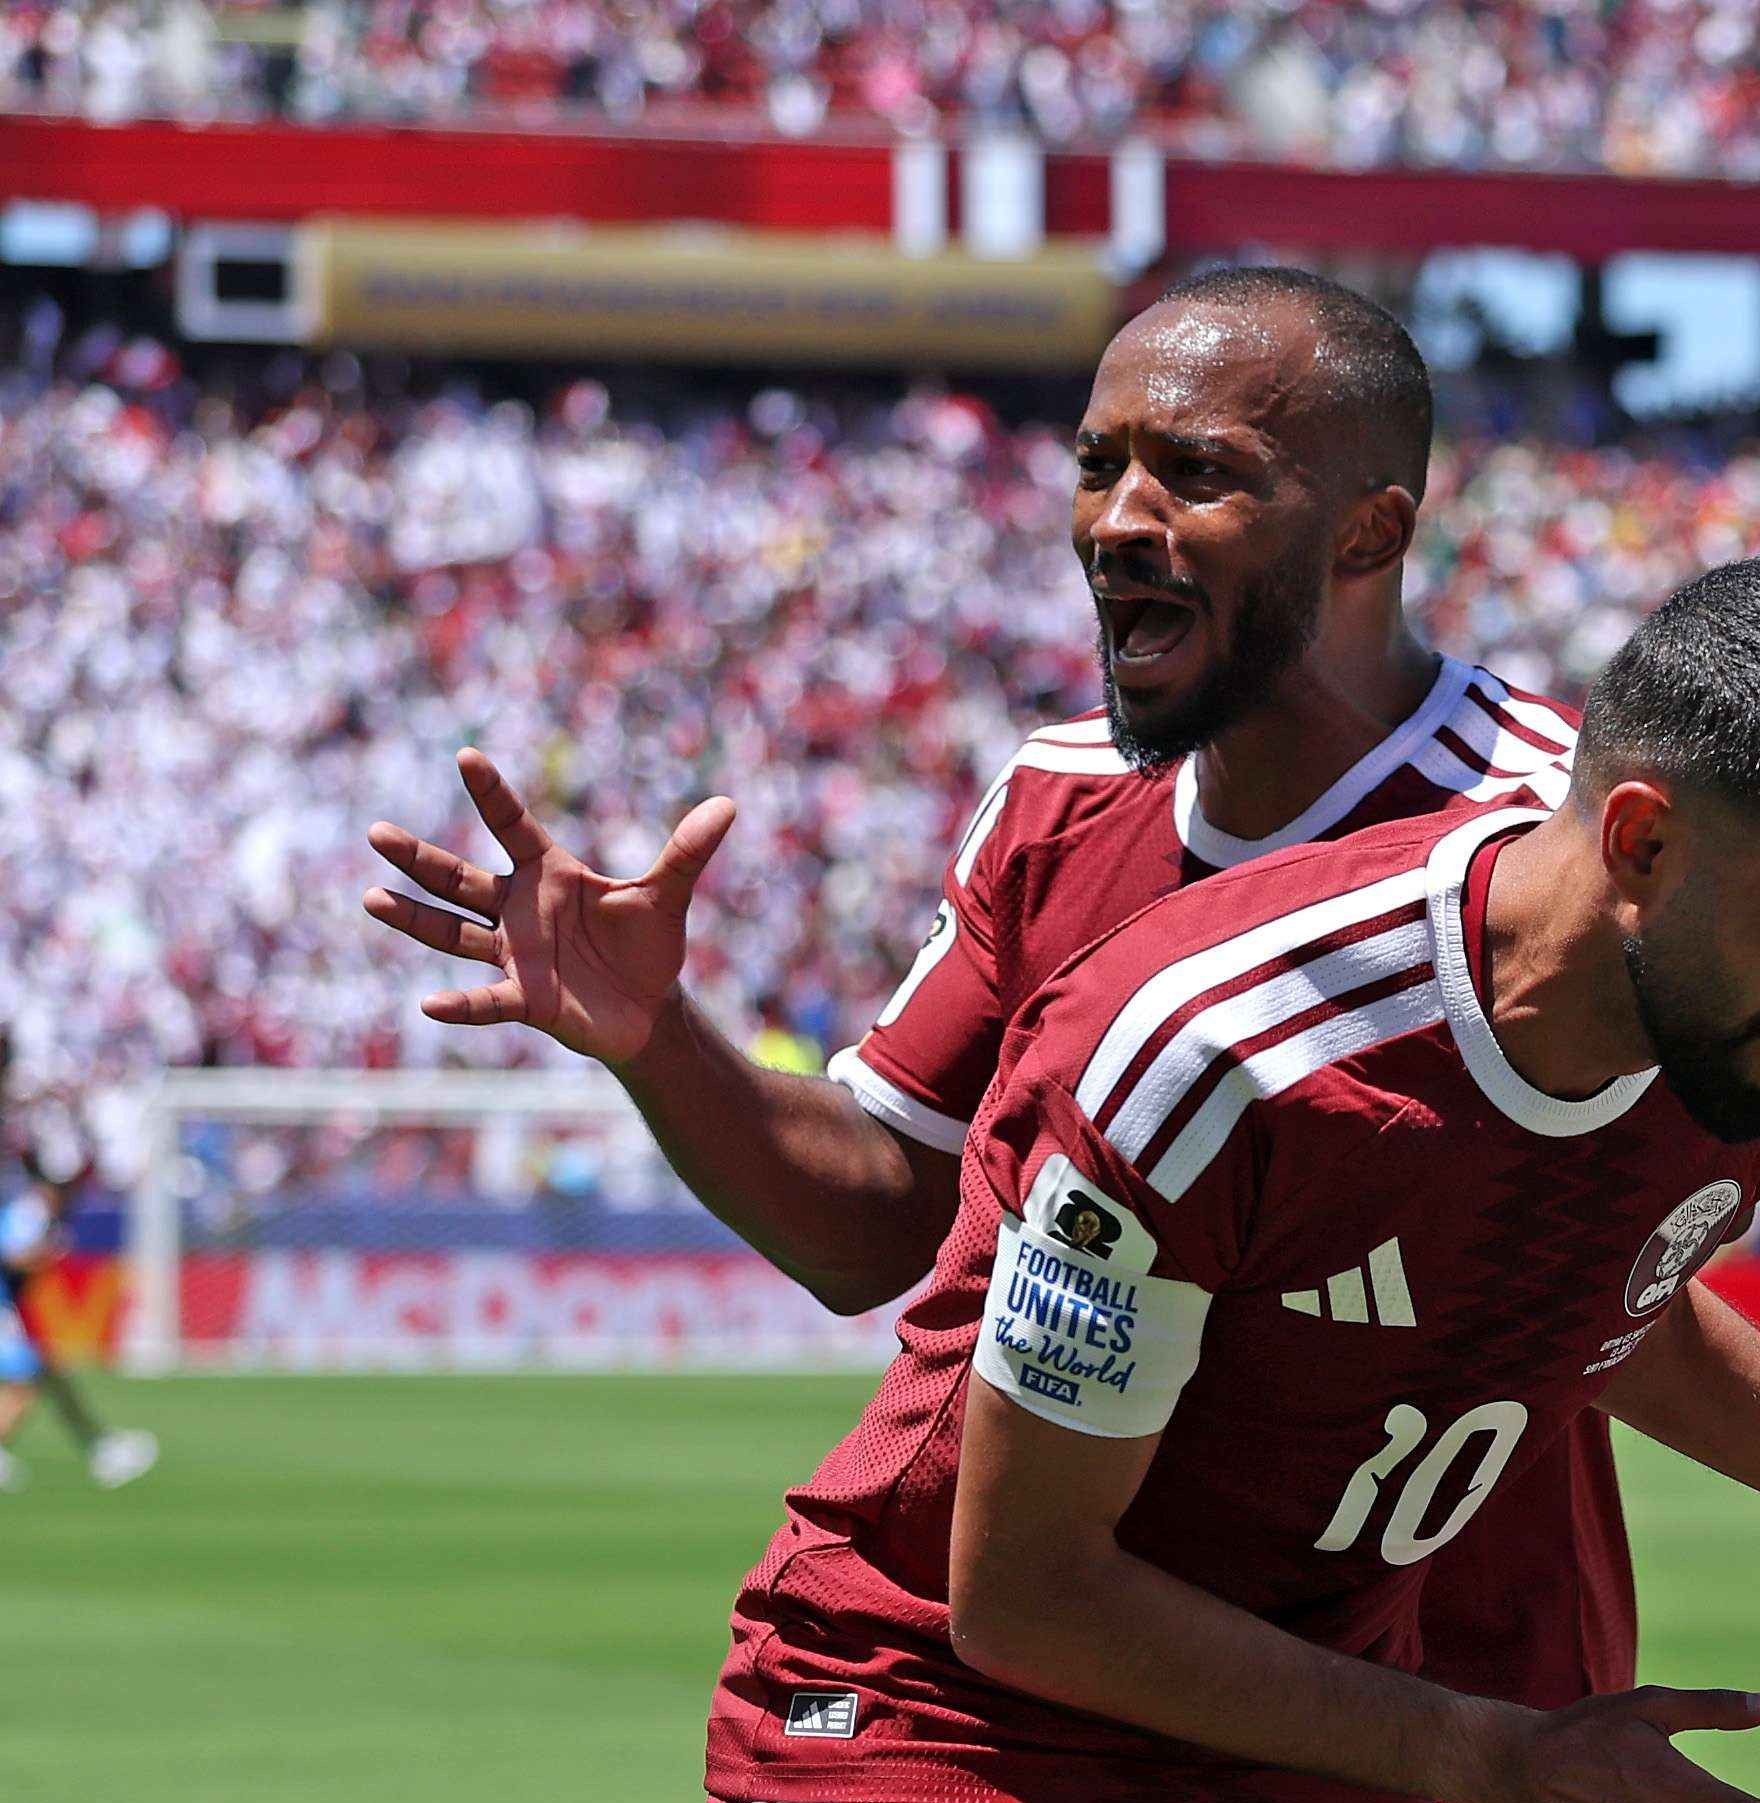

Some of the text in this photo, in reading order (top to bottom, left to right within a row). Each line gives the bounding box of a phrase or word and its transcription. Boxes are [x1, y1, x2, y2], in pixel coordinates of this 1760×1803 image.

[1007, 1272, 1136, 1355] UNITES
[1016, 1241, 1138, 1313] FOOTBALL
[994, 1314, 1137, 1394] the World
[1022, 1367, 1076, 1402] FIFA
[1313, 1400, 1529, 1566] 10
